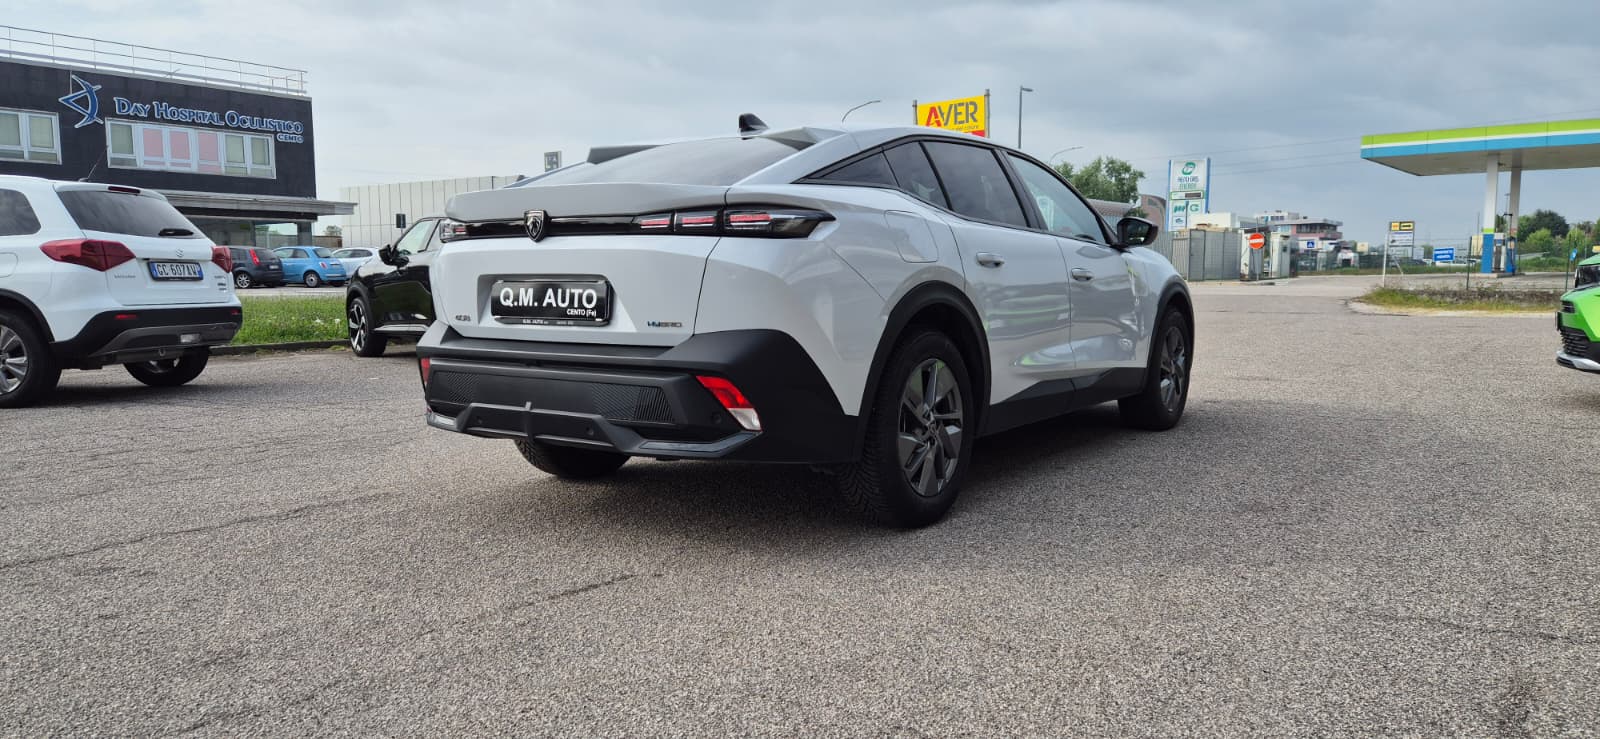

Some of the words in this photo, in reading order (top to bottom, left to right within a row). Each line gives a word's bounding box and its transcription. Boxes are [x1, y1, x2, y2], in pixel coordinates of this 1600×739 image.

[113, 97, 150, 117] DAY
[153, 101, 224, 126] HOSPITAL
[225, 110, 304, 133] OCULISTICO
[925, 101, 978, 127] AVER
[277, 134, 304, 143] CENTO
[500, 287, 538, 307] Q.M.
[542, 287, 597, 309] AUTO
[566, 308, 586, 316] CENTO
